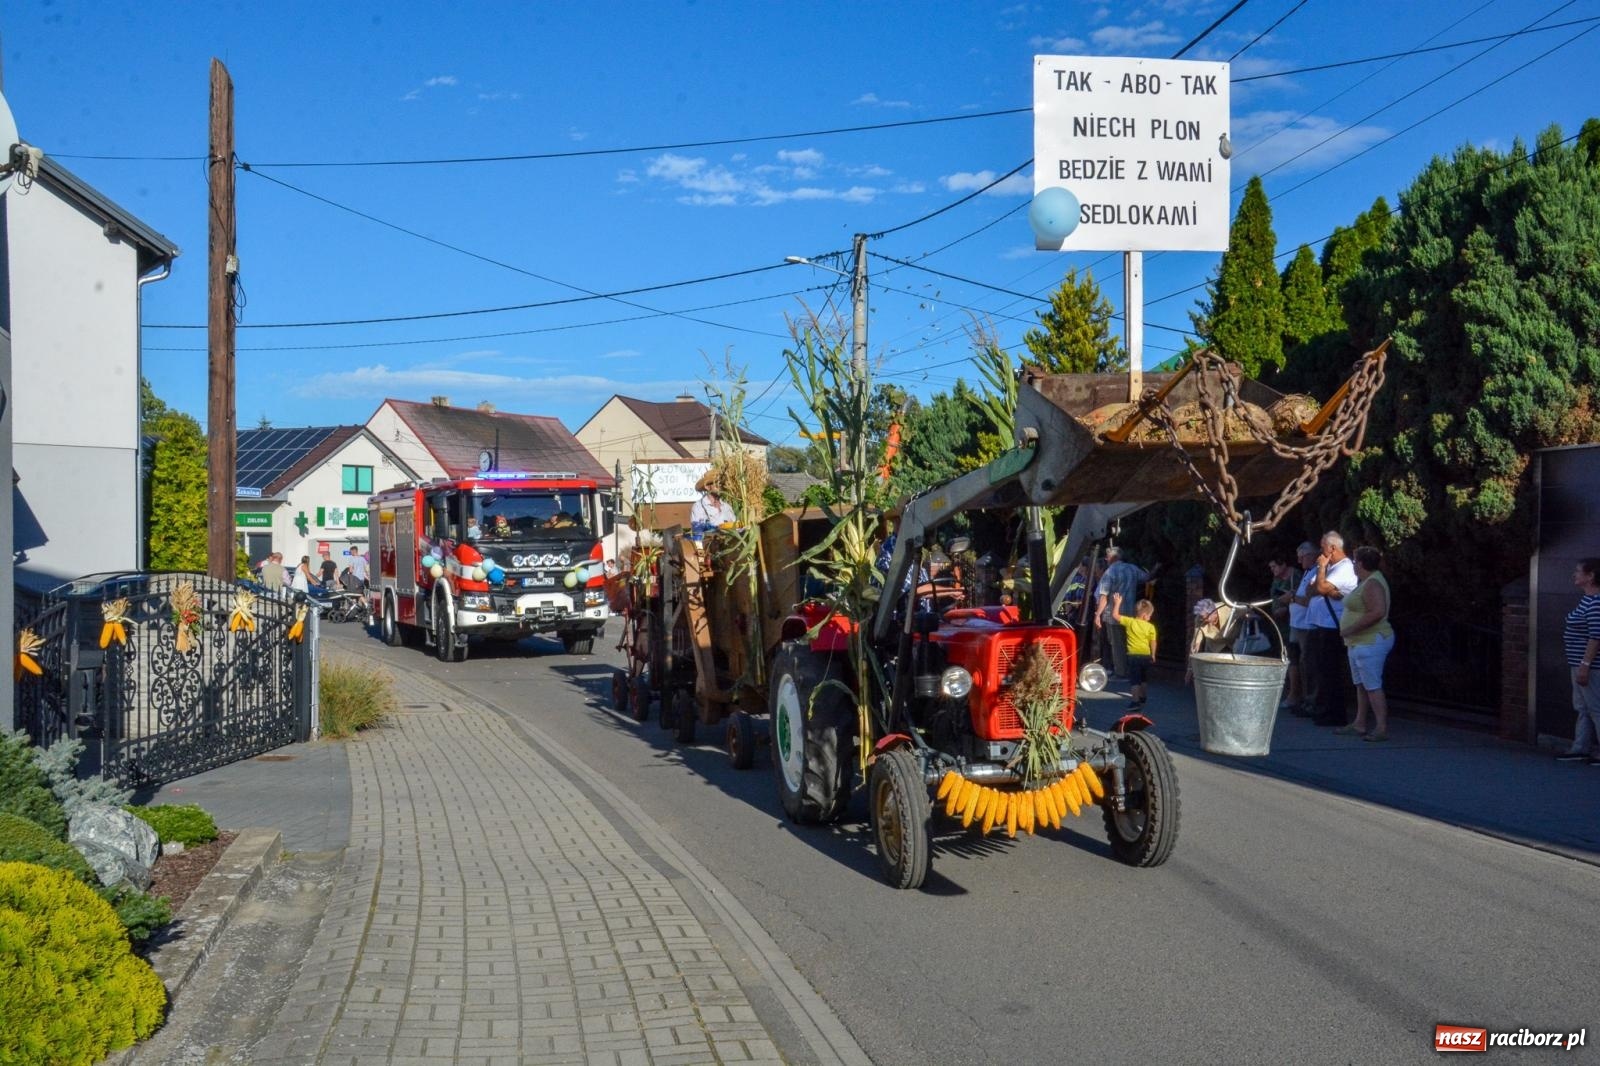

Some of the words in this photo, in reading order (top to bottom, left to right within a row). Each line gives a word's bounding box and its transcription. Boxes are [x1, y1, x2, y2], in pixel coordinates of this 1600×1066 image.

[1054, 70, 1092, 92] TAK
[1121, 73, 1160, 94] ABO
[1181, 76, 1217, 95] TAK
[1074, 113, 1135, 137] NIECH
[1151, 119, 1200, 140] PLON
[1137, 161, 1147, 180] Z
[1157, 158, 1211, 182] WAMI
